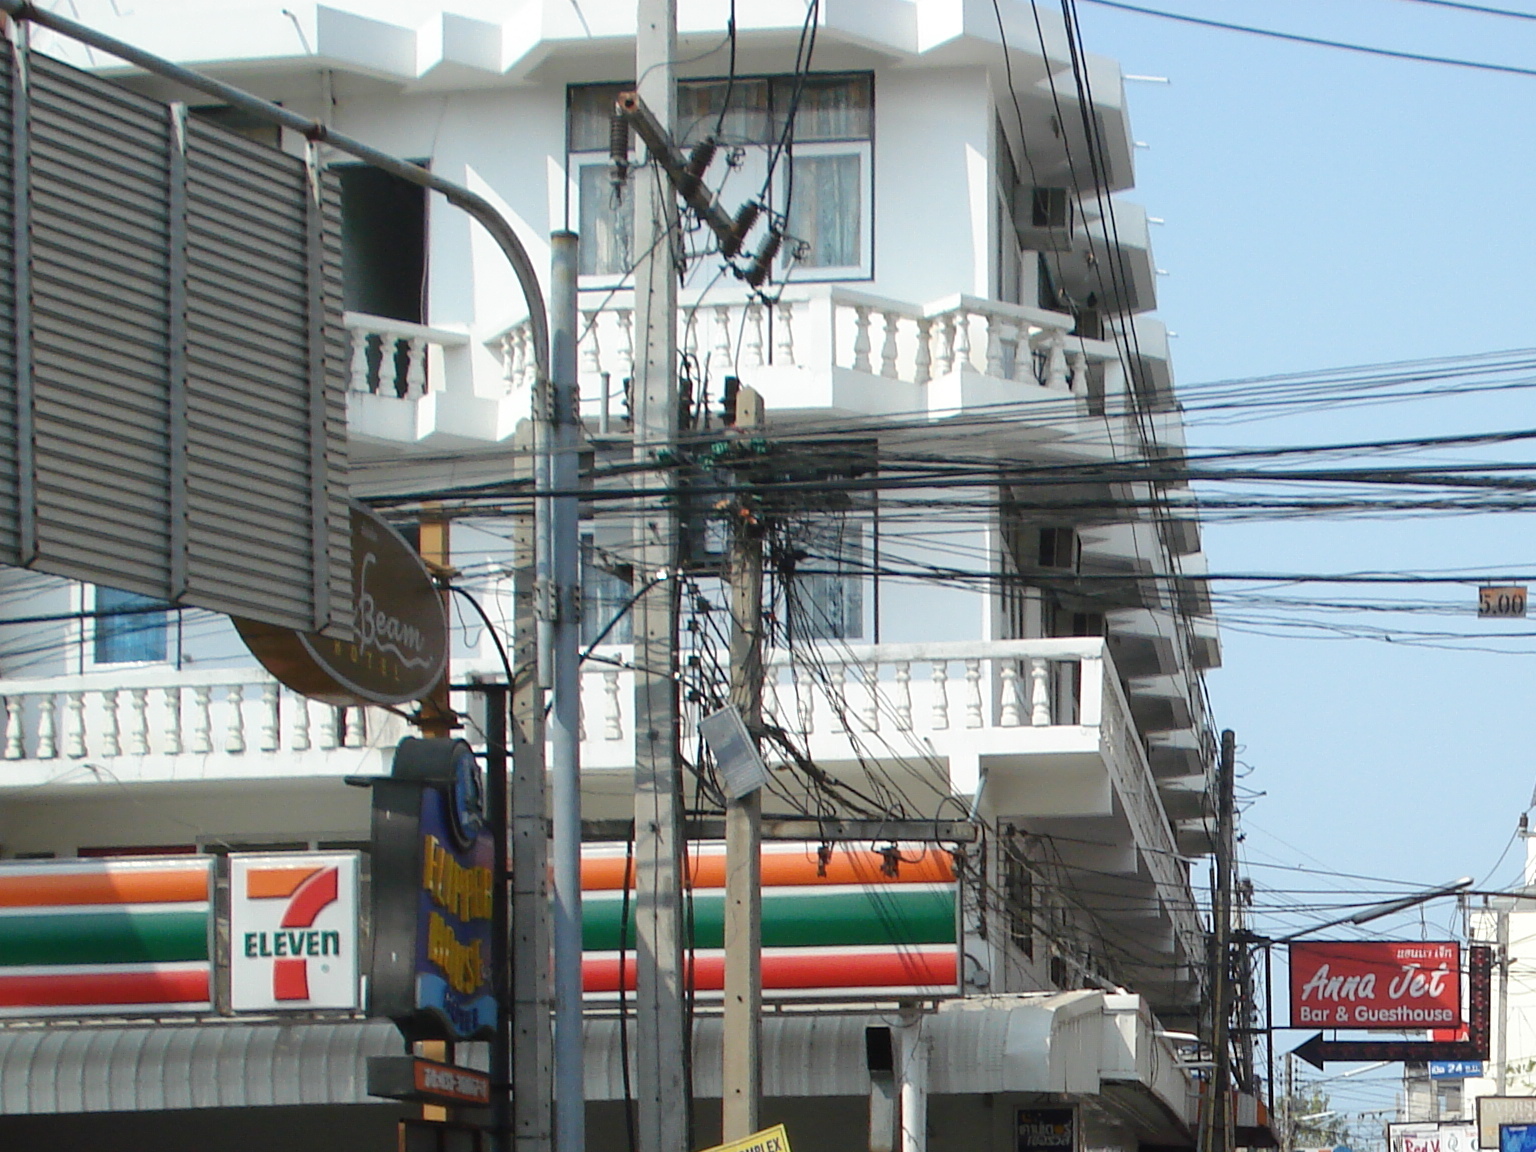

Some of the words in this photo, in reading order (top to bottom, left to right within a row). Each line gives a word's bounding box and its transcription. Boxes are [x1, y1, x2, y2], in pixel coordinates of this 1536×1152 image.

[246, 866, 339, 1001] 7
[1301, 963, 1376, 1002] Anna
[1388, 962, 1450, 1000] Jet
[1300, 1006, 1330, 1022] Bar
[1335, 1006, 1349, 1022] &
[1354, 1005, 1453, 1022] Guesthouse
[1447, 1062, 1463, 1074] 24
